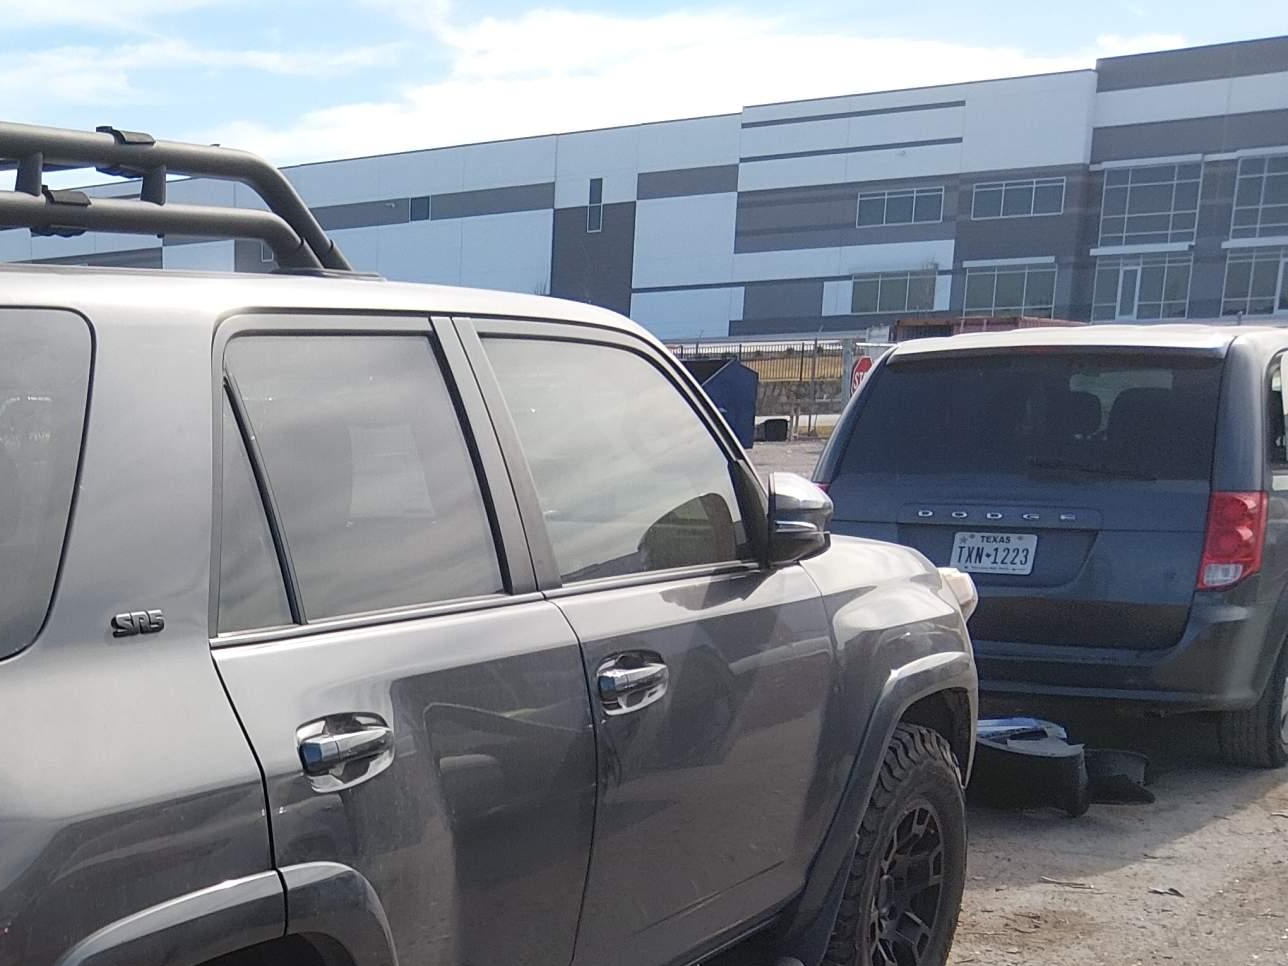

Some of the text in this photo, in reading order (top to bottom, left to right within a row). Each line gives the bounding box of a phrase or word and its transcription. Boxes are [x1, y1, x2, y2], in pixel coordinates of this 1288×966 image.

[918, 509, 1076, 521] DODGE
[980, 535, 1011, 544] TEXAS
[111, 609, 165, 638] SR5
